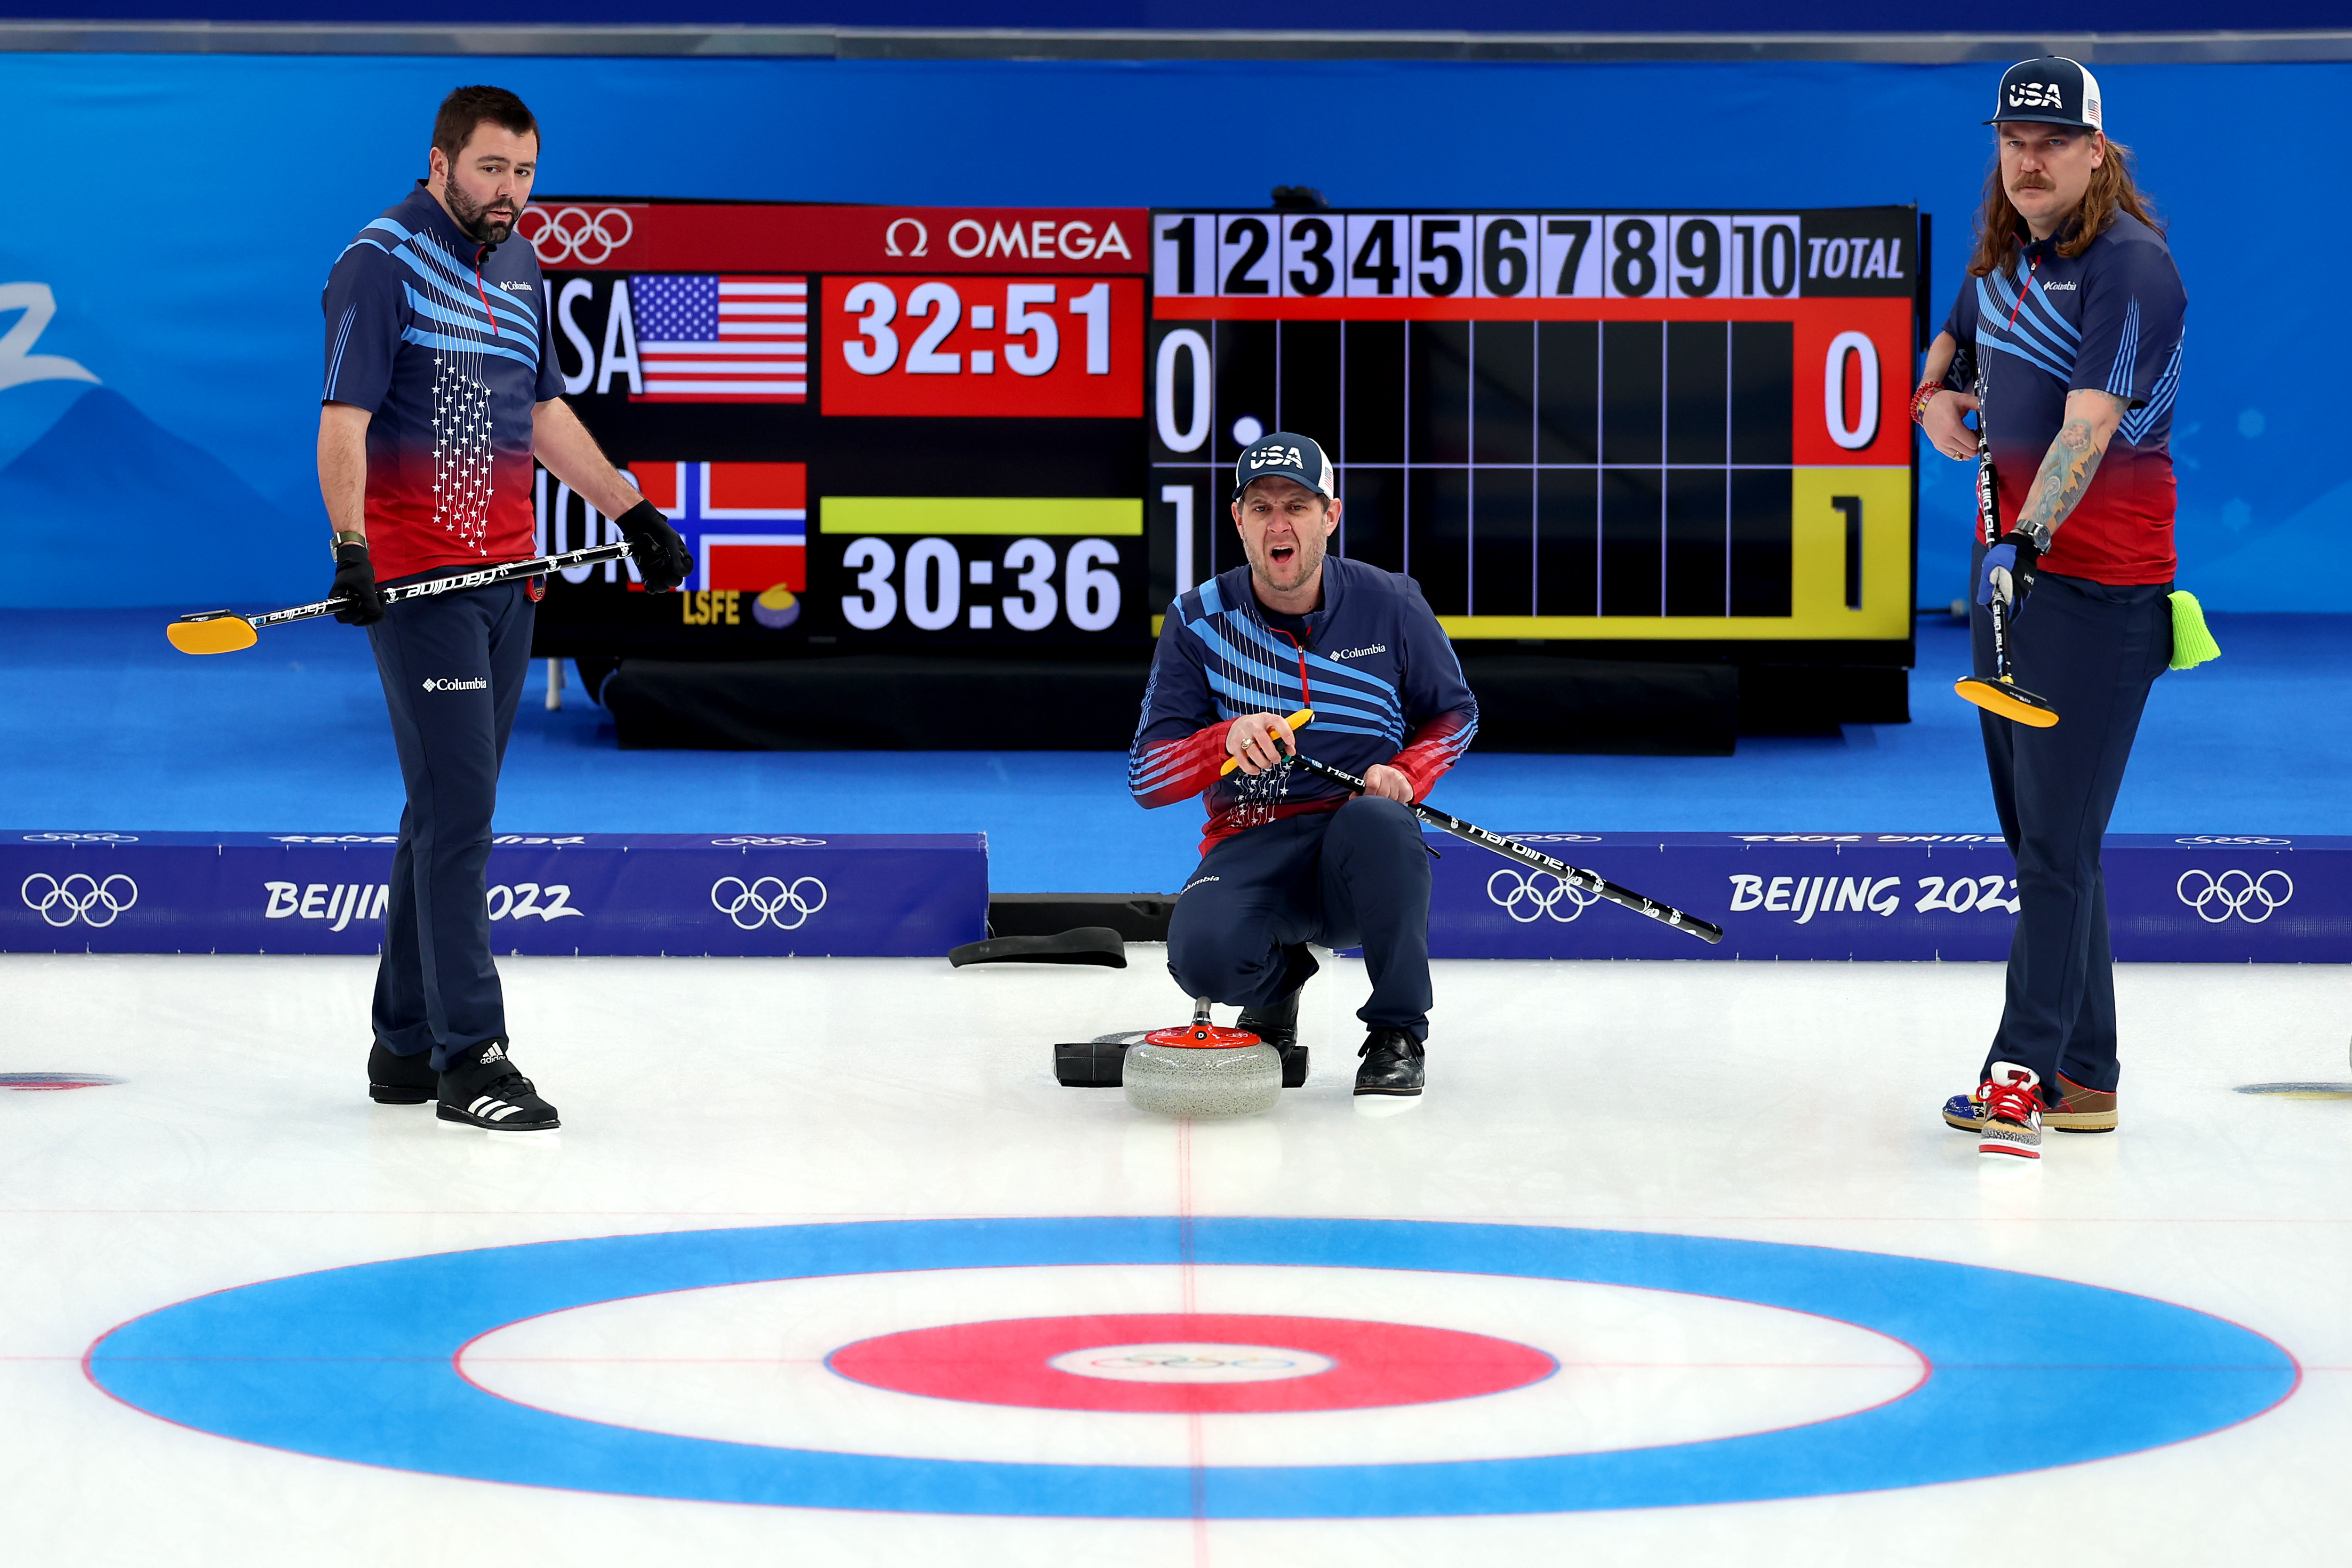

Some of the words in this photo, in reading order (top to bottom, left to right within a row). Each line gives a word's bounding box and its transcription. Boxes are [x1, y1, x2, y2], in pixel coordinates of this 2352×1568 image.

[2009, 83, 2063, 109] USA
[948, 220, 1132, 260] OMEGA
[1163, 219, 1196, 294] 1
[1224, 219, 1269, 294] 2
[1290, 219, 1335, 295] 3
[1352, 220, 1399, 294] 4
[1419, 221, 1463, 295] 5
[1483, 219, 1528, 297] 6
[1547, 221, 1591, 294] 7
[1612, 219, 1657, 297] 8
[1676, 220, 1721, 297] 9
[1733, 225, 1796, 297] 10
[1809, 238, 1904, 278] TOTAL
[507, 281, 532, 291] Columbia
[843, 282, 1110, 377] 32:51
[1156, 329, 1212, 453] 0
[1825, 331, 1879, 449] 0
[1250, 445, 1303, 469] USA
[1162, 485, 1194, 593] 1
[1831, 495, 1864, 610] 1
[842, 538, 1121, 631] 30:36
[683, 590, 740, 625] LSFE
[1341, 644, 1386, 659] Columbia
[437, 677, 486, 691] Columbia
[486, 883, 585, 922] 022
[1729, 875, 1901, 925] BEIJING
